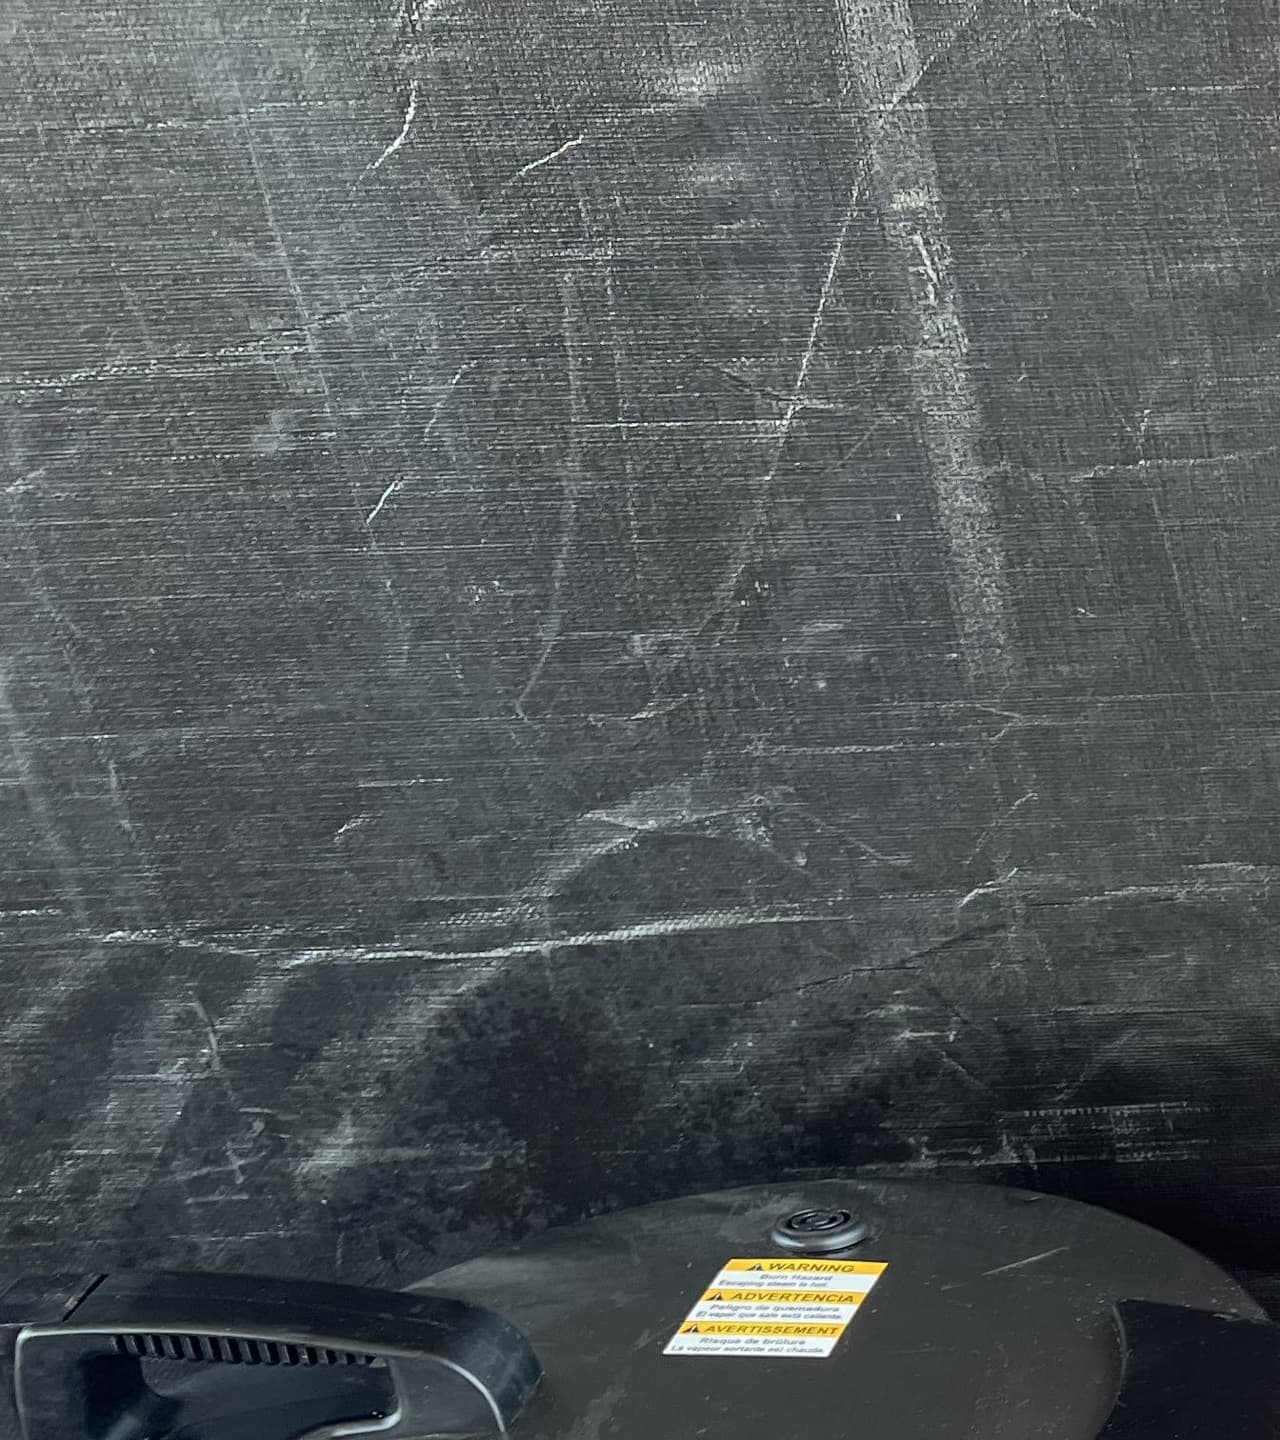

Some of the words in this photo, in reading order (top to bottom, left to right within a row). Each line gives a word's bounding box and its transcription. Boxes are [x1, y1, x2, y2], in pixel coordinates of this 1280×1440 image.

[768, 1263, 855, 1272] WARNING
[729, 1292, 854, 1302] ADVERTENCIA
[703, 1325, 840, 1335] AVERTISSEMENT
